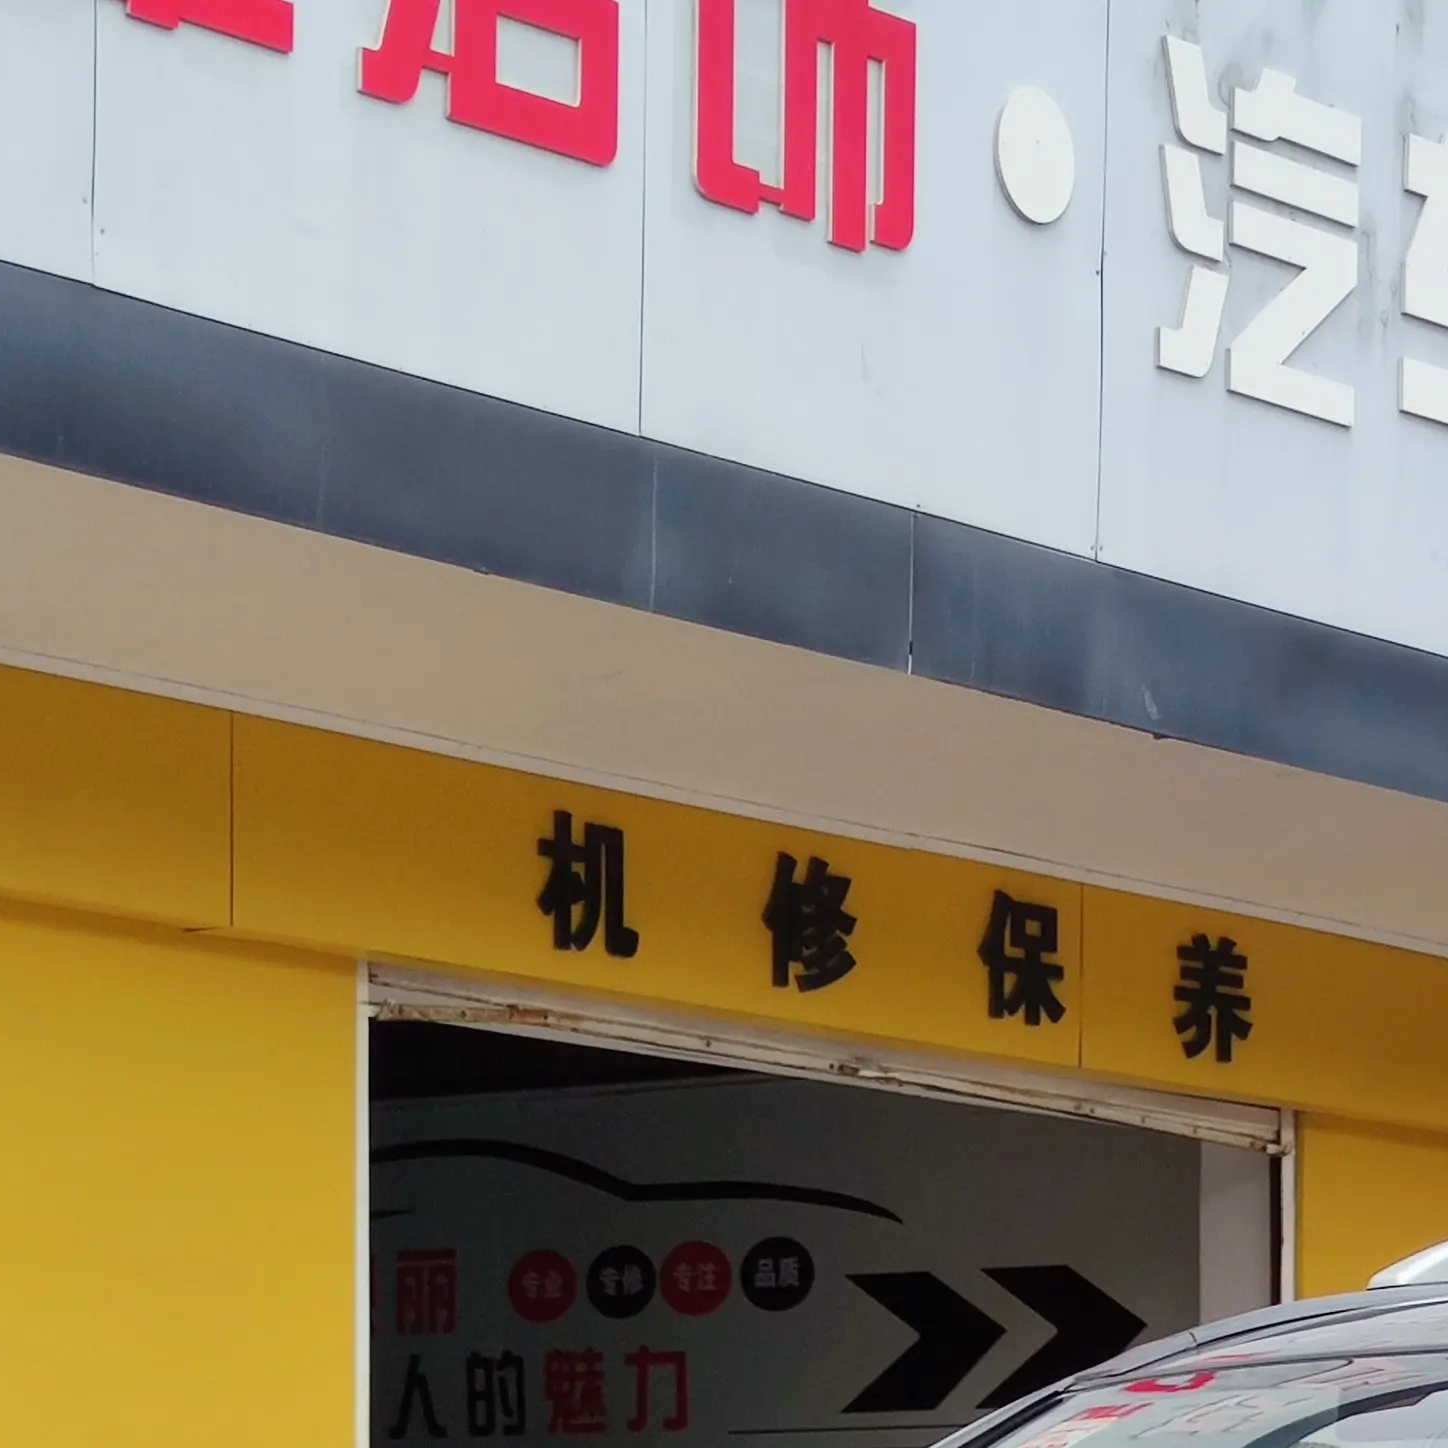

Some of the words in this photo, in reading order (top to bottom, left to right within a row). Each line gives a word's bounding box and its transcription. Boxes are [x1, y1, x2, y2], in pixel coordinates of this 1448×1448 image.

[536, 809, 1255, 1064] 机修保养
[753, 1255, 801, 1289] 品质
[388, 1345, 693, 1440] 人的魅力
